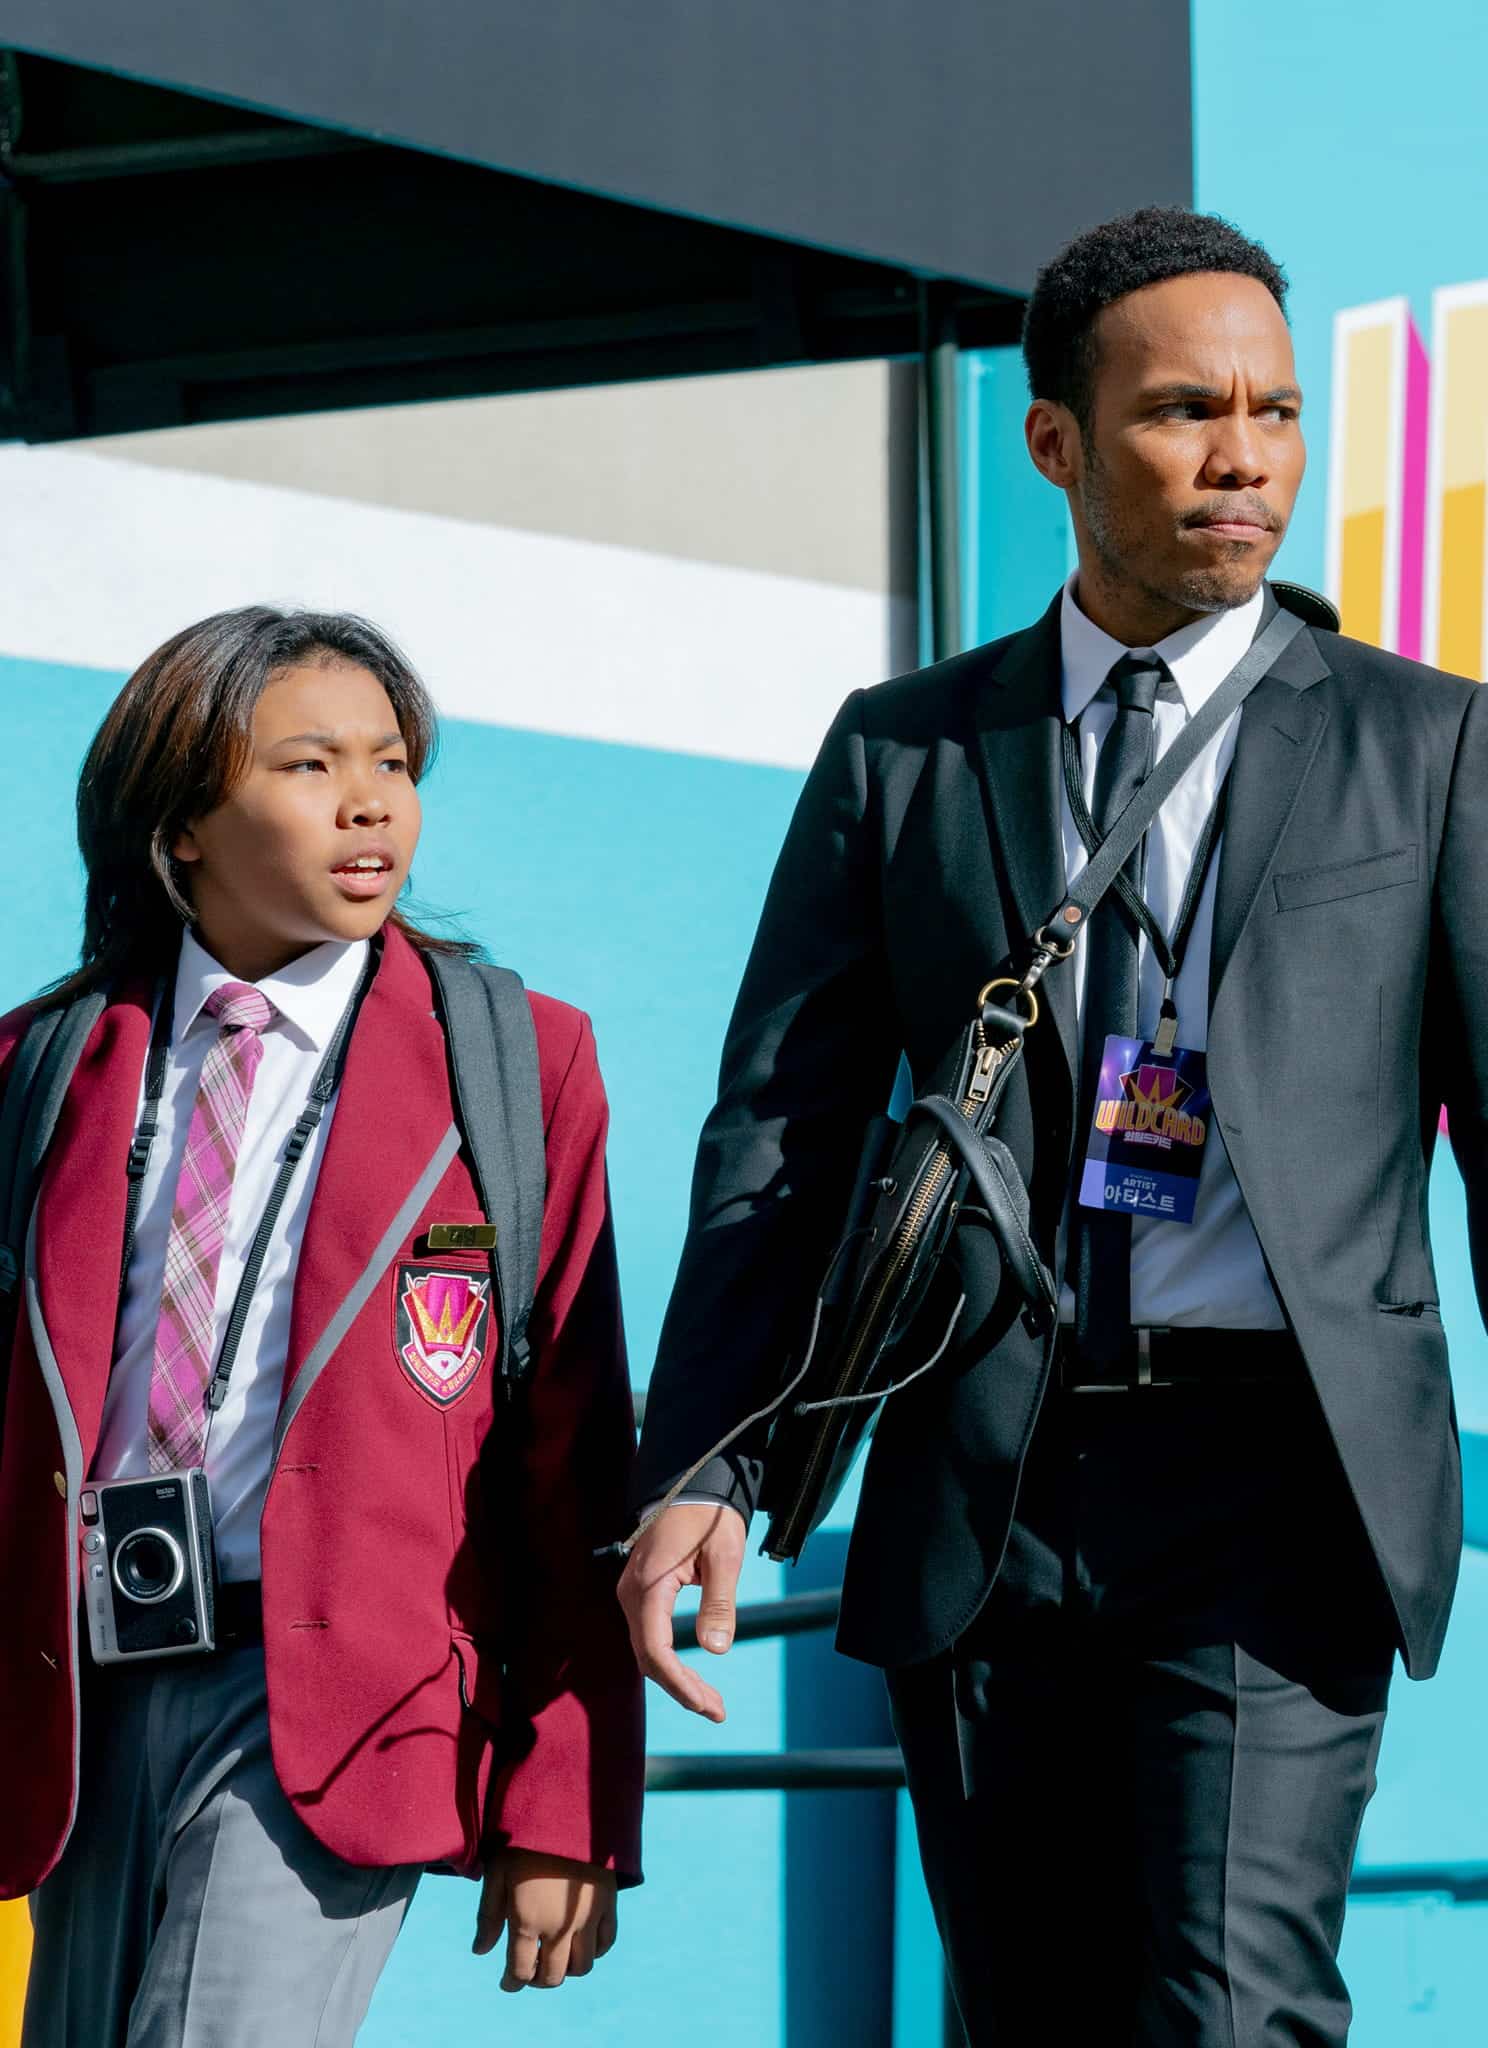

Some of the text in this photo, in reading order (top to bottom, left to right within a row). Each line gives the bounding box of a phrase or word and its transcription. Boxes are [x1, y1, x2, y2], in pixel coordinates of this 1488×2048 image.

[1096, 1100, 1205, 1146] WILDCARD
[1123, 1178, 1157, 1191] ARTIST
[1104, 1185, 1175, 1212] 아티스트
